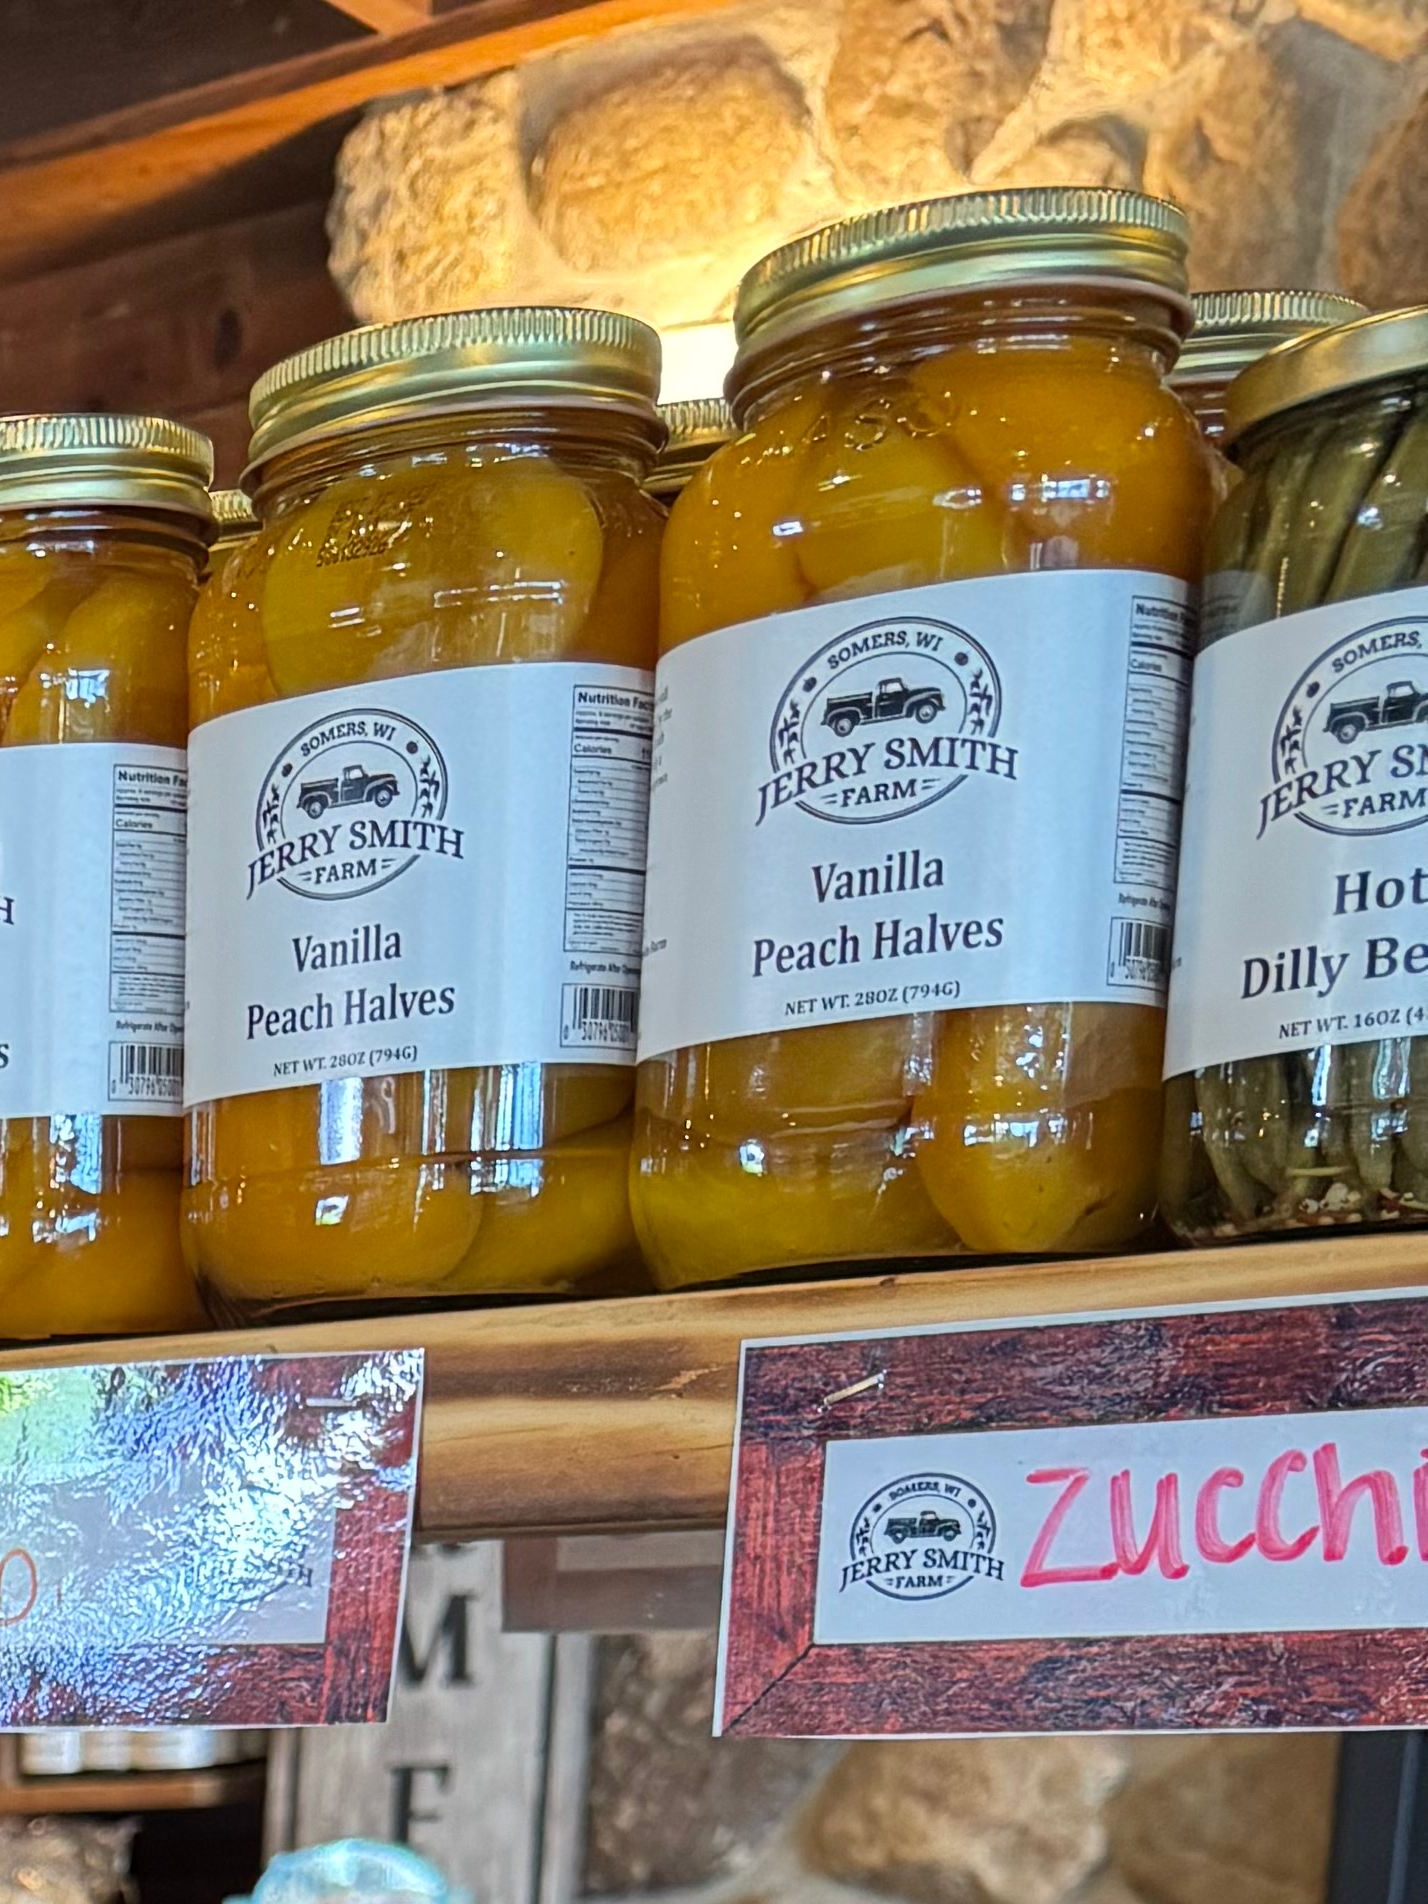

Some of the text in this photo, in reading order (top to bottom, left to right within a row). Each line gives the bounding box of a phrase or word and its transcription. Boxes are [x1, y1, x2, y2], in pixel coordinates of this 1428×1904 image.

[827, 630, 944, 669] SOMERS, WI
[1331, 631, 1421, 672] SOMERS,
[578, 692, 631, 708] Nutrition
[300, 721, 396, 757] SOMERS, WI
[118, 770, 171, 786] Nutrition
[755, 737, 1019, 827] JERRY SMITH
[841, 778, 918, 808] FARM
[1256, 749, 1383, 840] JERRY
[1343, 787, 1428, 819] FARM
[246, 820, 464, 900] JERRY SMITH
[314, 858, 377, 885] FARM
[811, 849, 945, 903] Vanilla
[1333, 867, 1428, 916] Hot
[292, 924, 402, 973] Vanilla
[752, 912, 1004, 978] Peach Halves
[1241, 945, 1350, 1000] Dilly
[246, 983, 455, 1040] Peach Halves
[785, 998, 818, 1016] NET
[821, 994, 850, 1012] WT.
[902, 980, 961, 1005] (794G)
[1279, 1020, 1312, 1039] NET
[1316, 1015, 1348, 1033] WT.
[1406, 1006, 1428, 1026] (4
[273, 1060, 300, 1077] NET
[302, 1057, 326, 1072] WT.
[369, 1045, 418, 1068] (794G)
[839, 1548, 1005, 1593] JERRY SMITH
[895, 1575, 943, 1589] FARM
